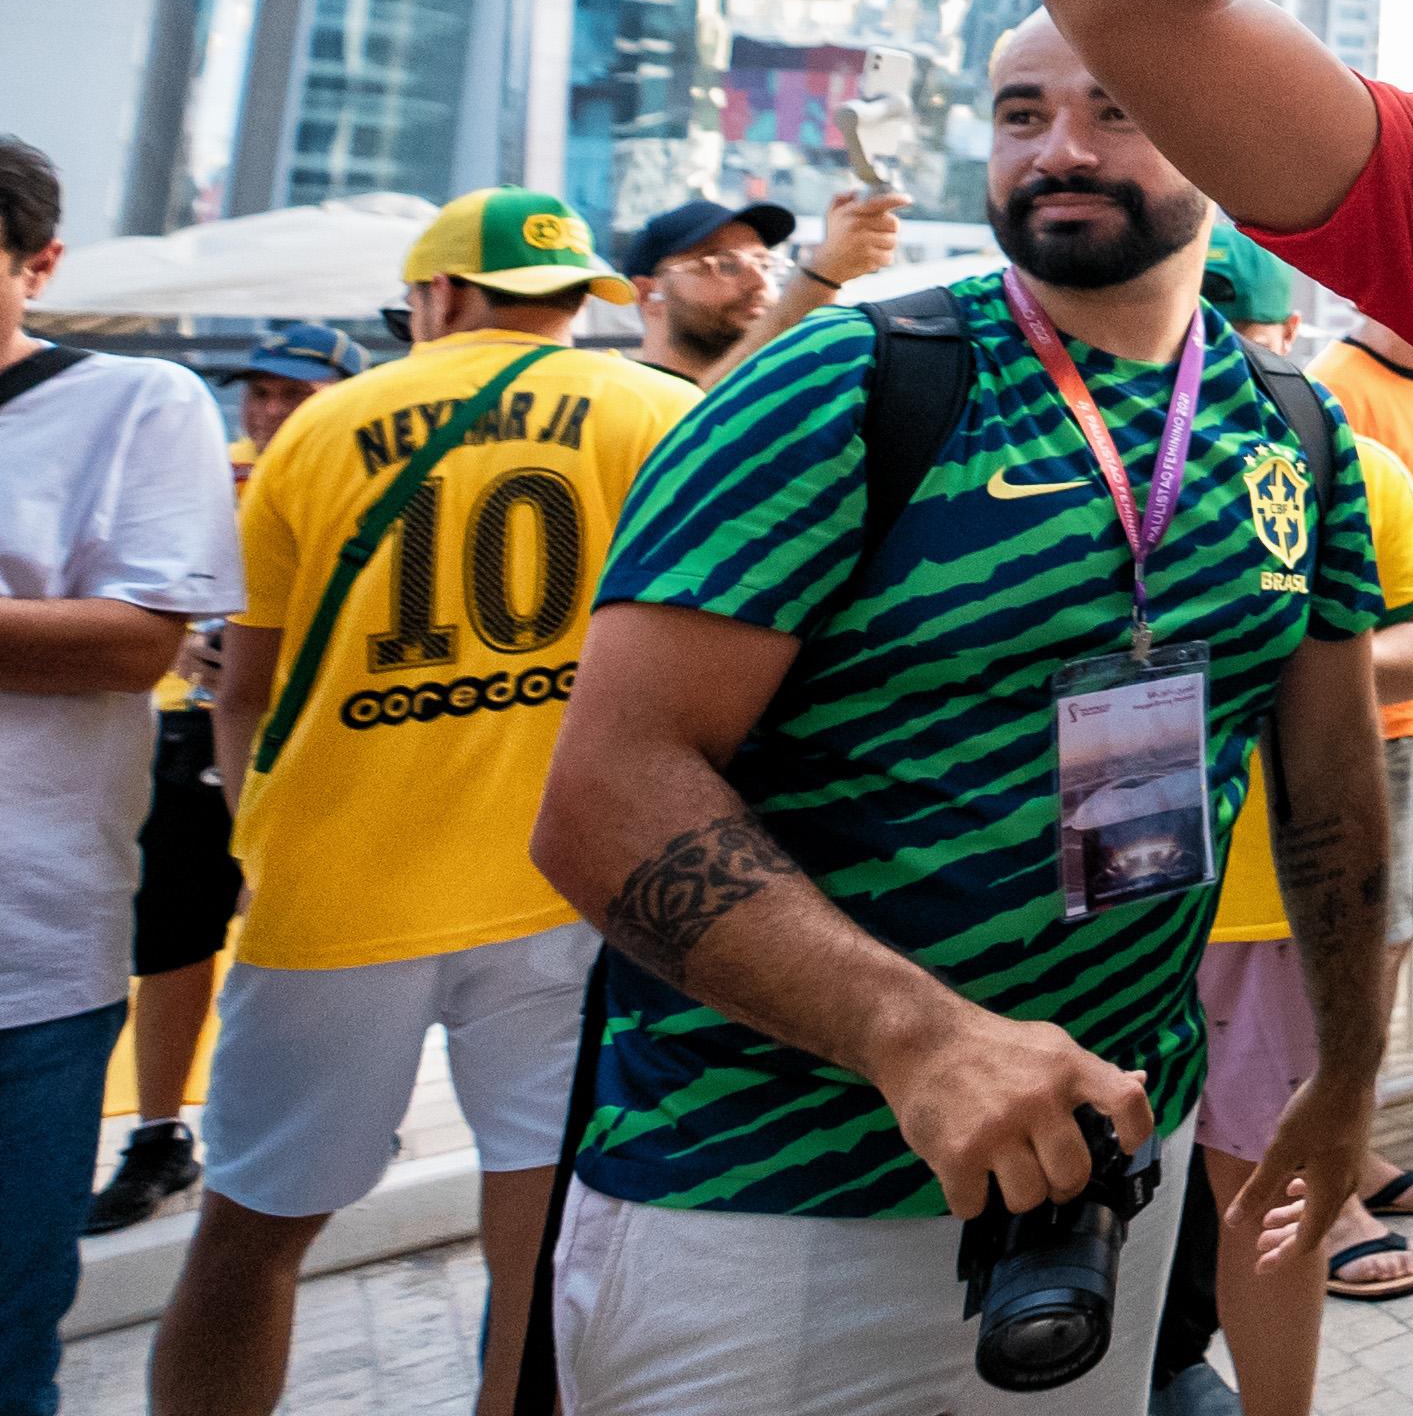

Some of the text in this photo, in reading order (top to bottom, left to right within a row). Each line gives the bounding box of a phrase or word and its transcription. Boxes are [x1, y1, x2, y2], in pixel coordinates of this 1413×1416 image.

[354, 391, 590, 478] NEYAR JR
[1162, 416, 1186, 472] FEMININO
[366, 467, 588, 675] 10
